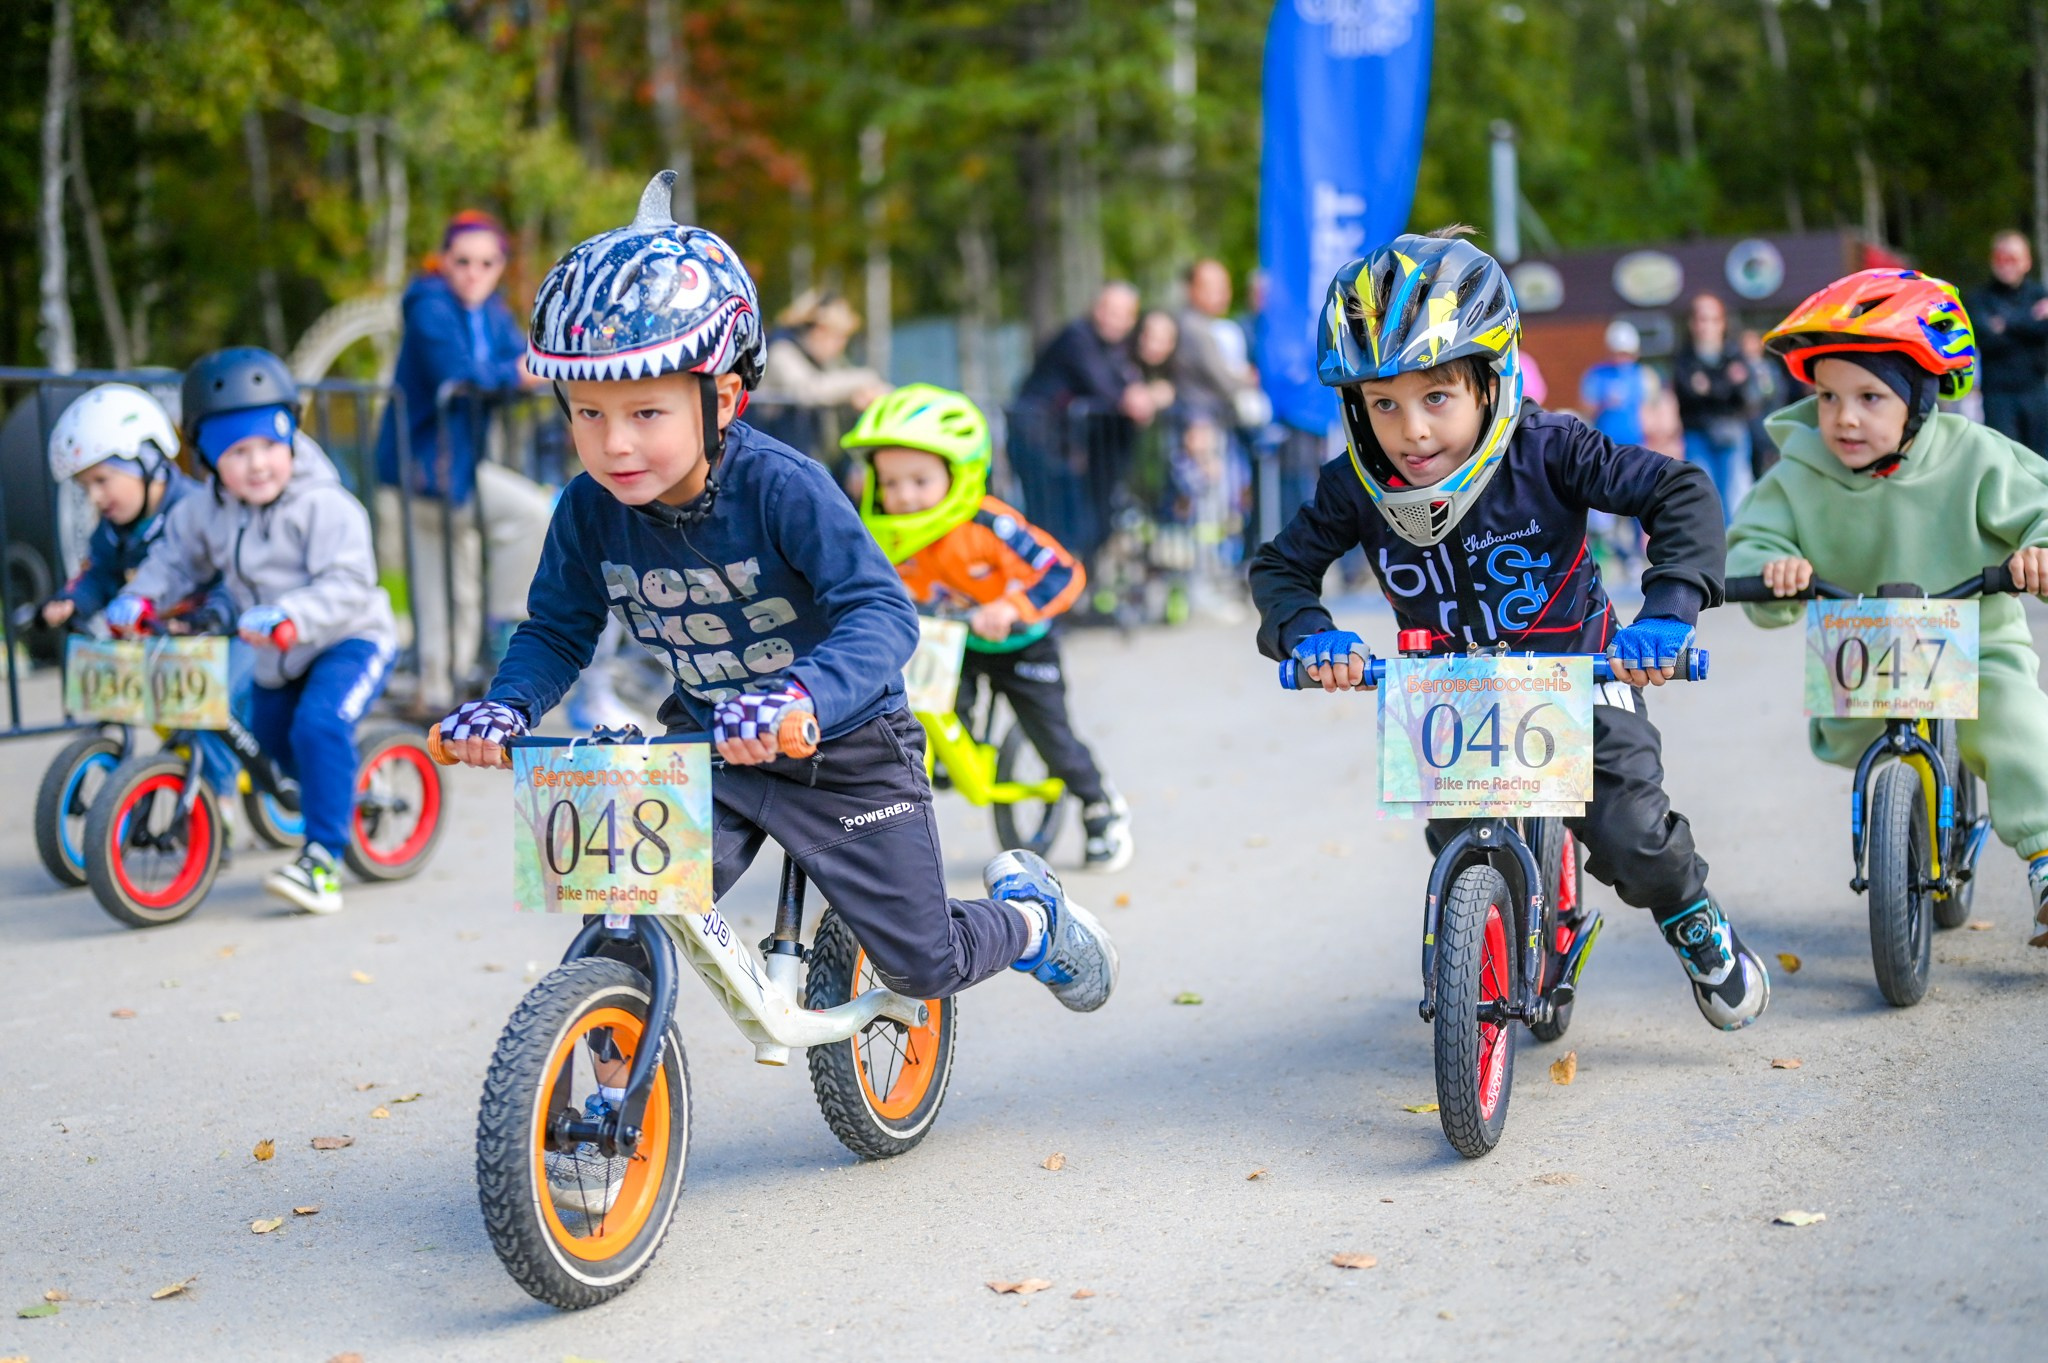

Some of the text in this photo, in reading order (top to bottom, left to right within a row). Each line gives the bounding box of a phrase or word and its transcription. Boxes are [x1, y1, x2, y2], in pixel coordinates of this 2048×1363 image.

[741, 597, 798, 634] a
[1836, 637, 1947, 691] 047
[1407, 675, 1572, 693] Беговелоосень
[1421, 702, 1556, 769] 046
[533, 766, 689, 788] Беговелоосень
[1434, 777, 1541, 792] Bike me Racing
[844, 802, 912, 828] POWERED
[545, 799, 671, 875] 048
[557, 886, 659, 905] Bike me Racing
